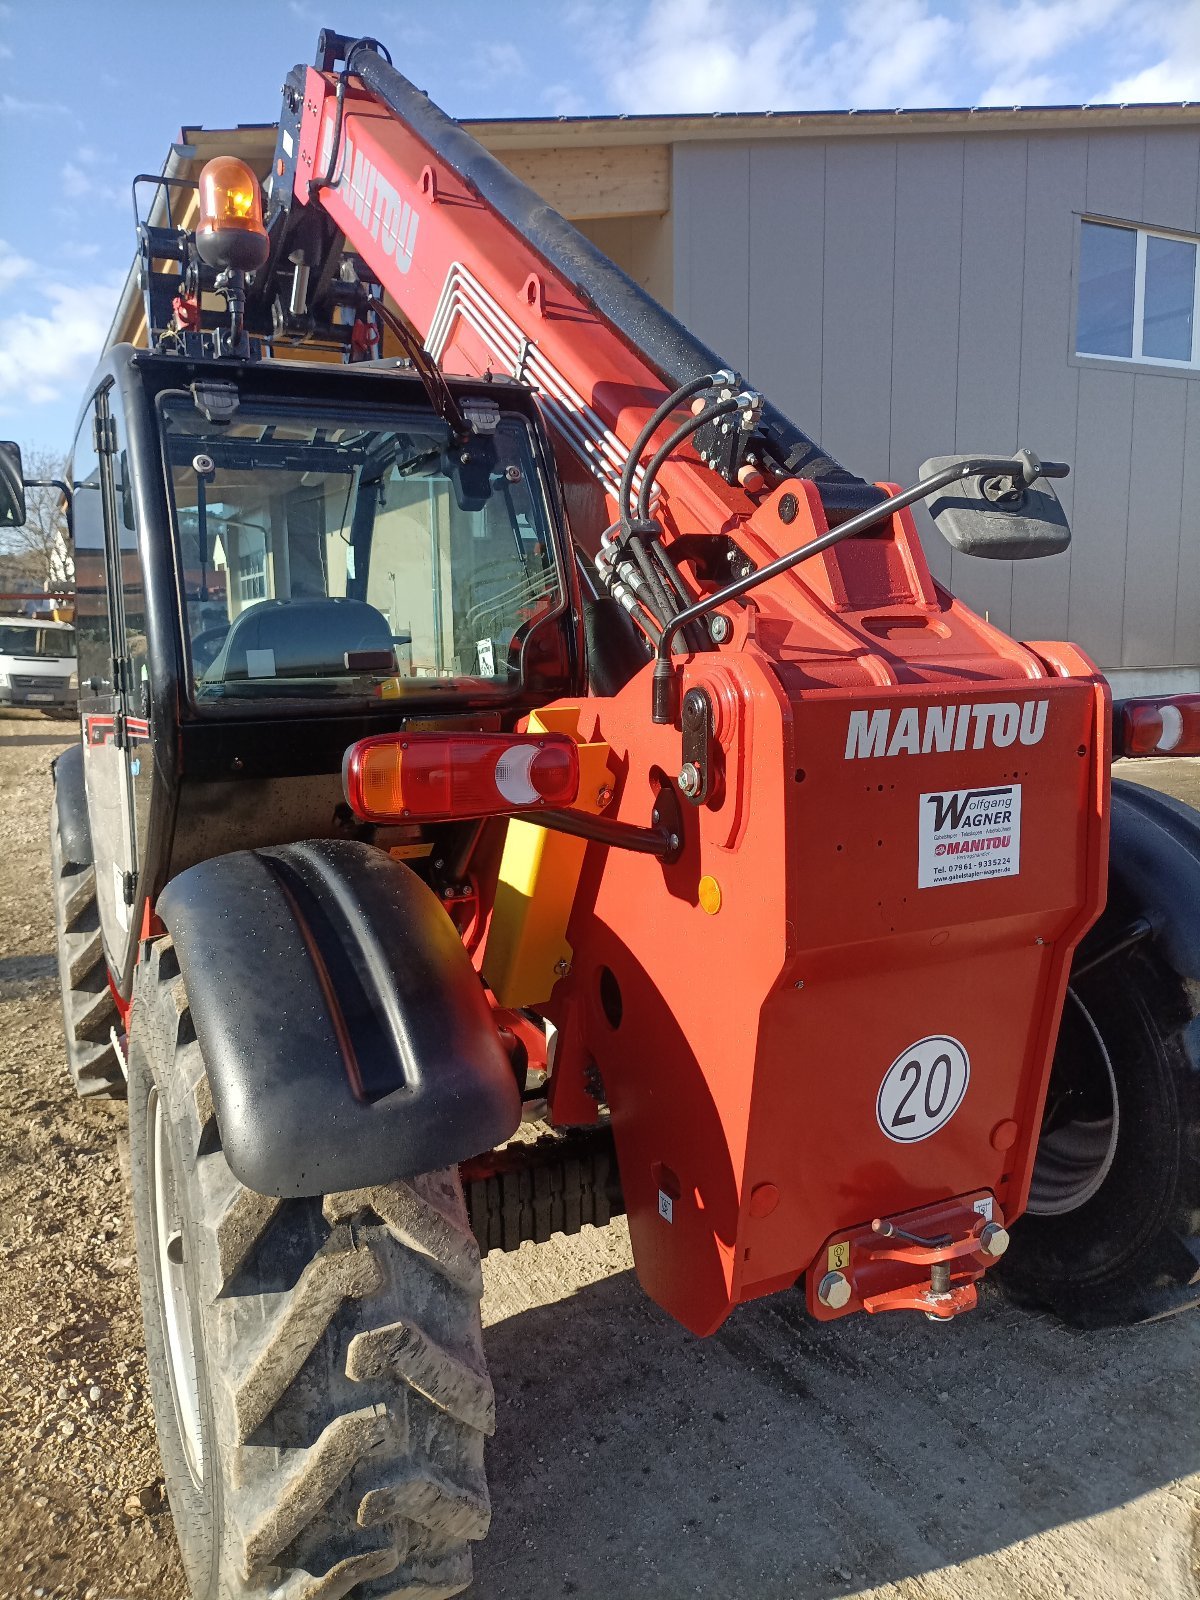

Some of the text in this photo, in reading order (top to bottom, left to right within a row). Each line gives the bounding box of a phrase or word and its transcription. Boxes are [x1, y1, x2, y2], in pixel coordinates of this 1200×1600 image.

[844, 699, 1049, 760] MANITOU
[947, 835, 1012, 855] MANITOU
[934, 866, 947, 875] Tel.
[891, 1054, 952, 1127] 20
